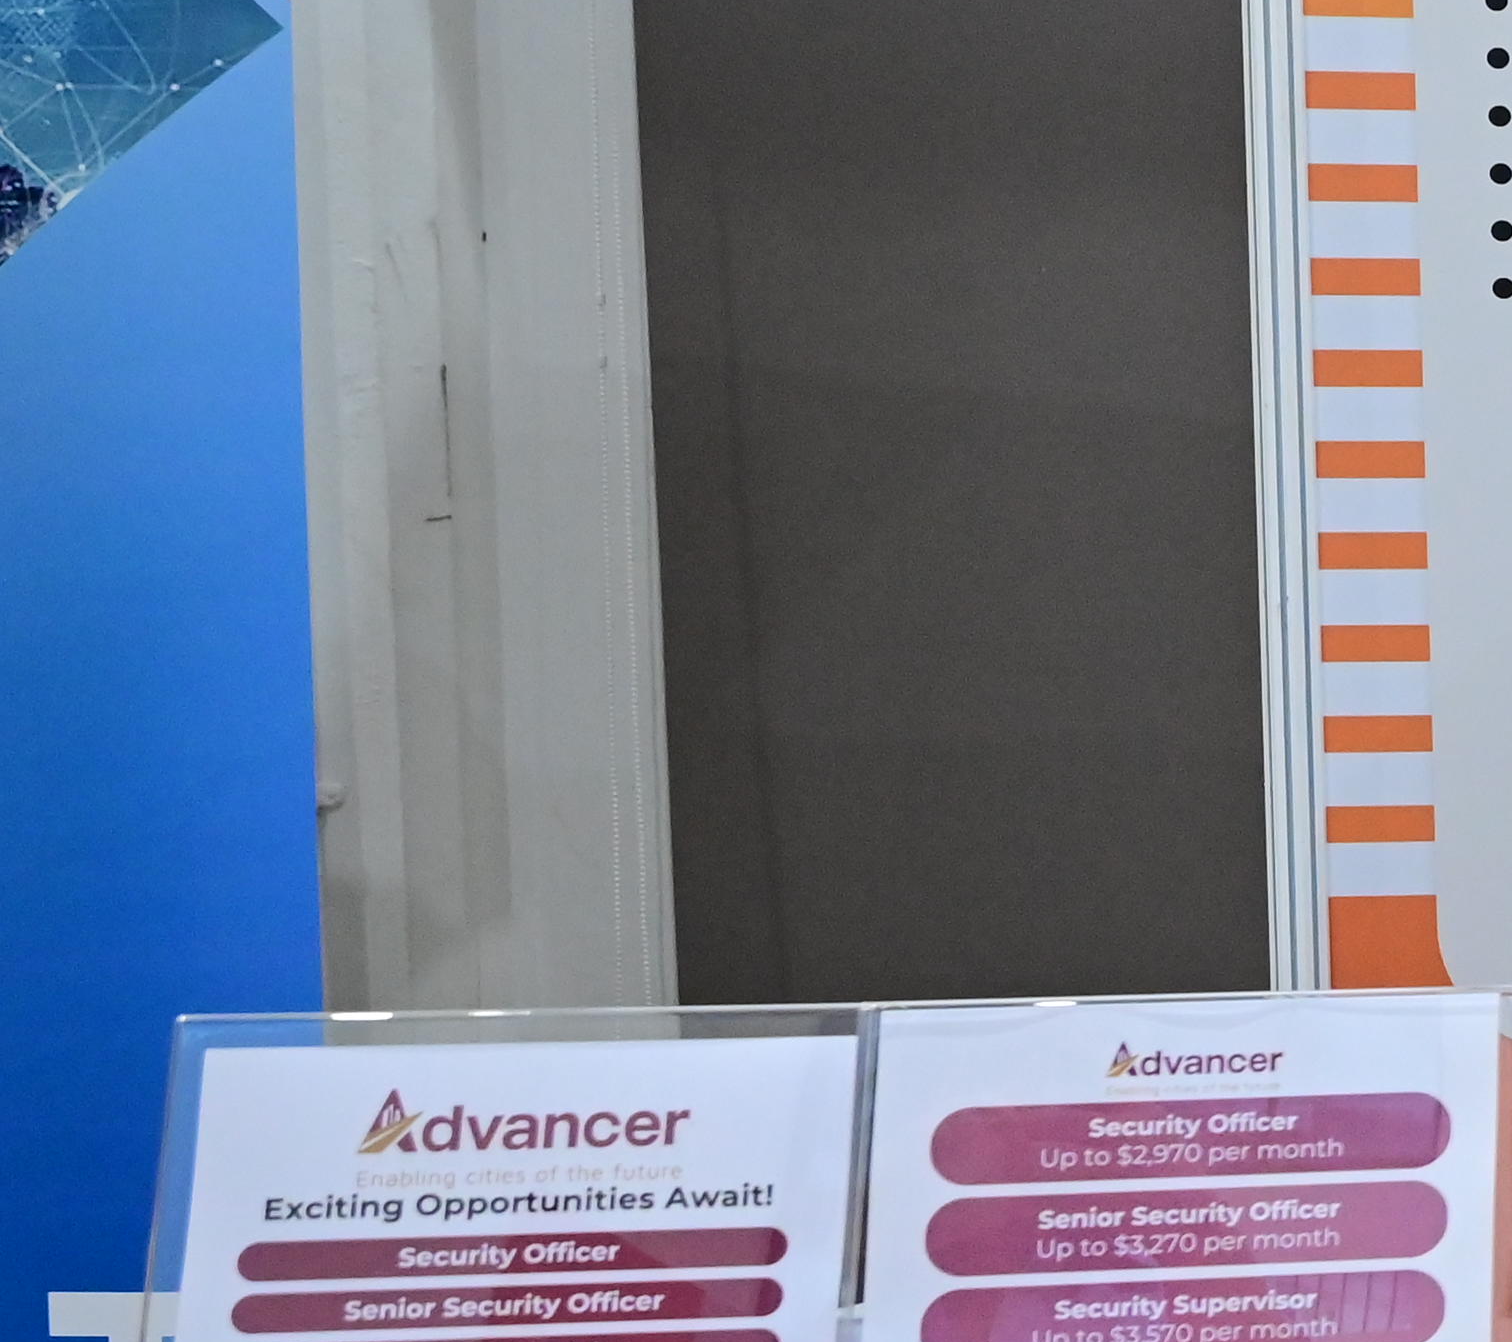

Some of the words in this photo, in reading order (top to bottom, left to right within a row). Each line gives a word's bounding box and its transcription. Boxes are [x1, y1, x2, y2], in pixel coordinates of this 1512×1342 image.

[1106, 1040, 1284, 1078] Advancer
[356, 1087, 691, 1154] Advancer
[1088, 1112, 1202, 1142] Security
[1207, 1111, 1298, 1136] Officer
[1040, 1147, 1078, 1171] Up
[1081, 1147, 1113, 1167] to
[1117, 1141, 1202, 1169] $2,970
[1207, 1143, 1253, 1165] per
[1258, 1137, 1344, 1159] month
[355, 1168, 456, 1190] Enabling
[465, 1163, 526, 1185] cities
[535, 1163, 561, 1182] of
[567, 1162, 603, 1181] the
[612, 1160, 684, 1181] future
[264, 1192, 403, 1224] Exciting
[415, 1186, 655, 1222] Opportunities
[664, 1182, 775, 1210] Await!
[1037, 1206, 1125, 1231] Senior
[1131, 1201, 1243, 1231] Security
[1249, 1198, 1341, 1223] Officer
[397, 1242, 517, 1272] Security
[523, 1240, 621, 1264] Officer
[1036, 1237, 1075, 1262] Up
[1079, 1236, 1109, 1257] to
[1113, 1231, 1198, 1259] $3,270
[1203, 1233, 1247, 1255] per
[1252, 1226, 1341, 1249] month
[344, 1297, 437, 1323] Senior
[441, 1292, 560, 1320] Security
[566, 1289, 665, 1314] Officer
[1053, 1294, 1167, 1323] Security
[1172, 1288, 1318, 1317] Supervisor
[1249, 1315, 1340, 1339] month
